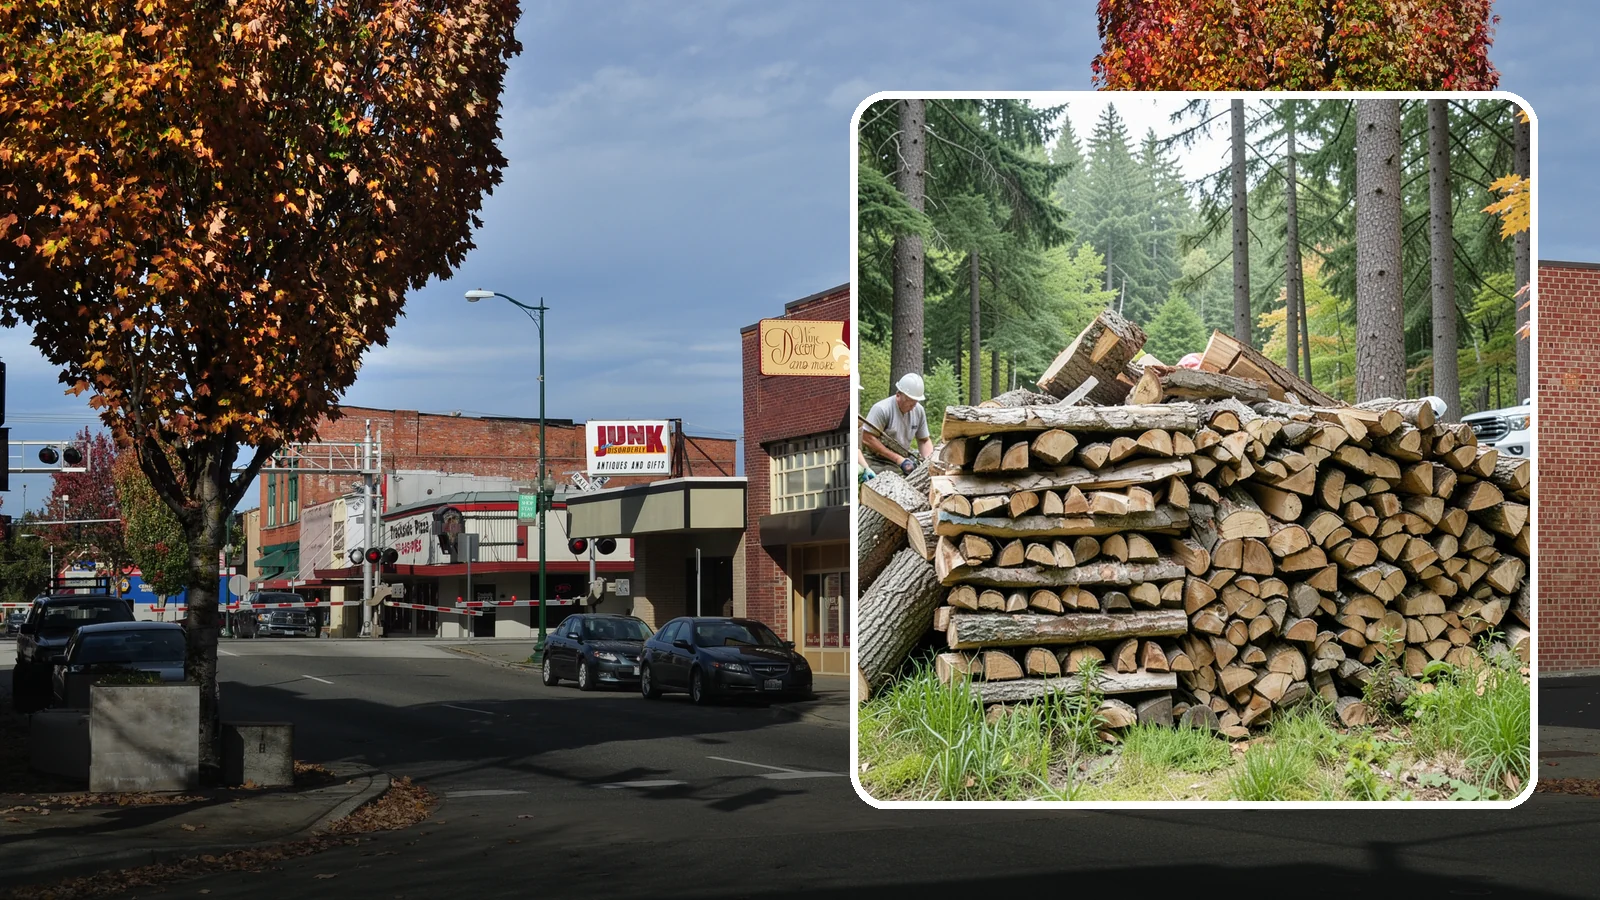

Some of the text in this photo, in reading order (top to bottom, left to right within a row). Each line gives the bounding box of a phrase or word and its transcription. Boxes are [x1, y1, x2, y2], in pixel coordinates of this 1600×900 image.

[595, 425, 666, 457] JUNK
[597, 460, 665, 470] ANTIQUES AND GIFTS
[414, 519, 429, 535] Pizza
